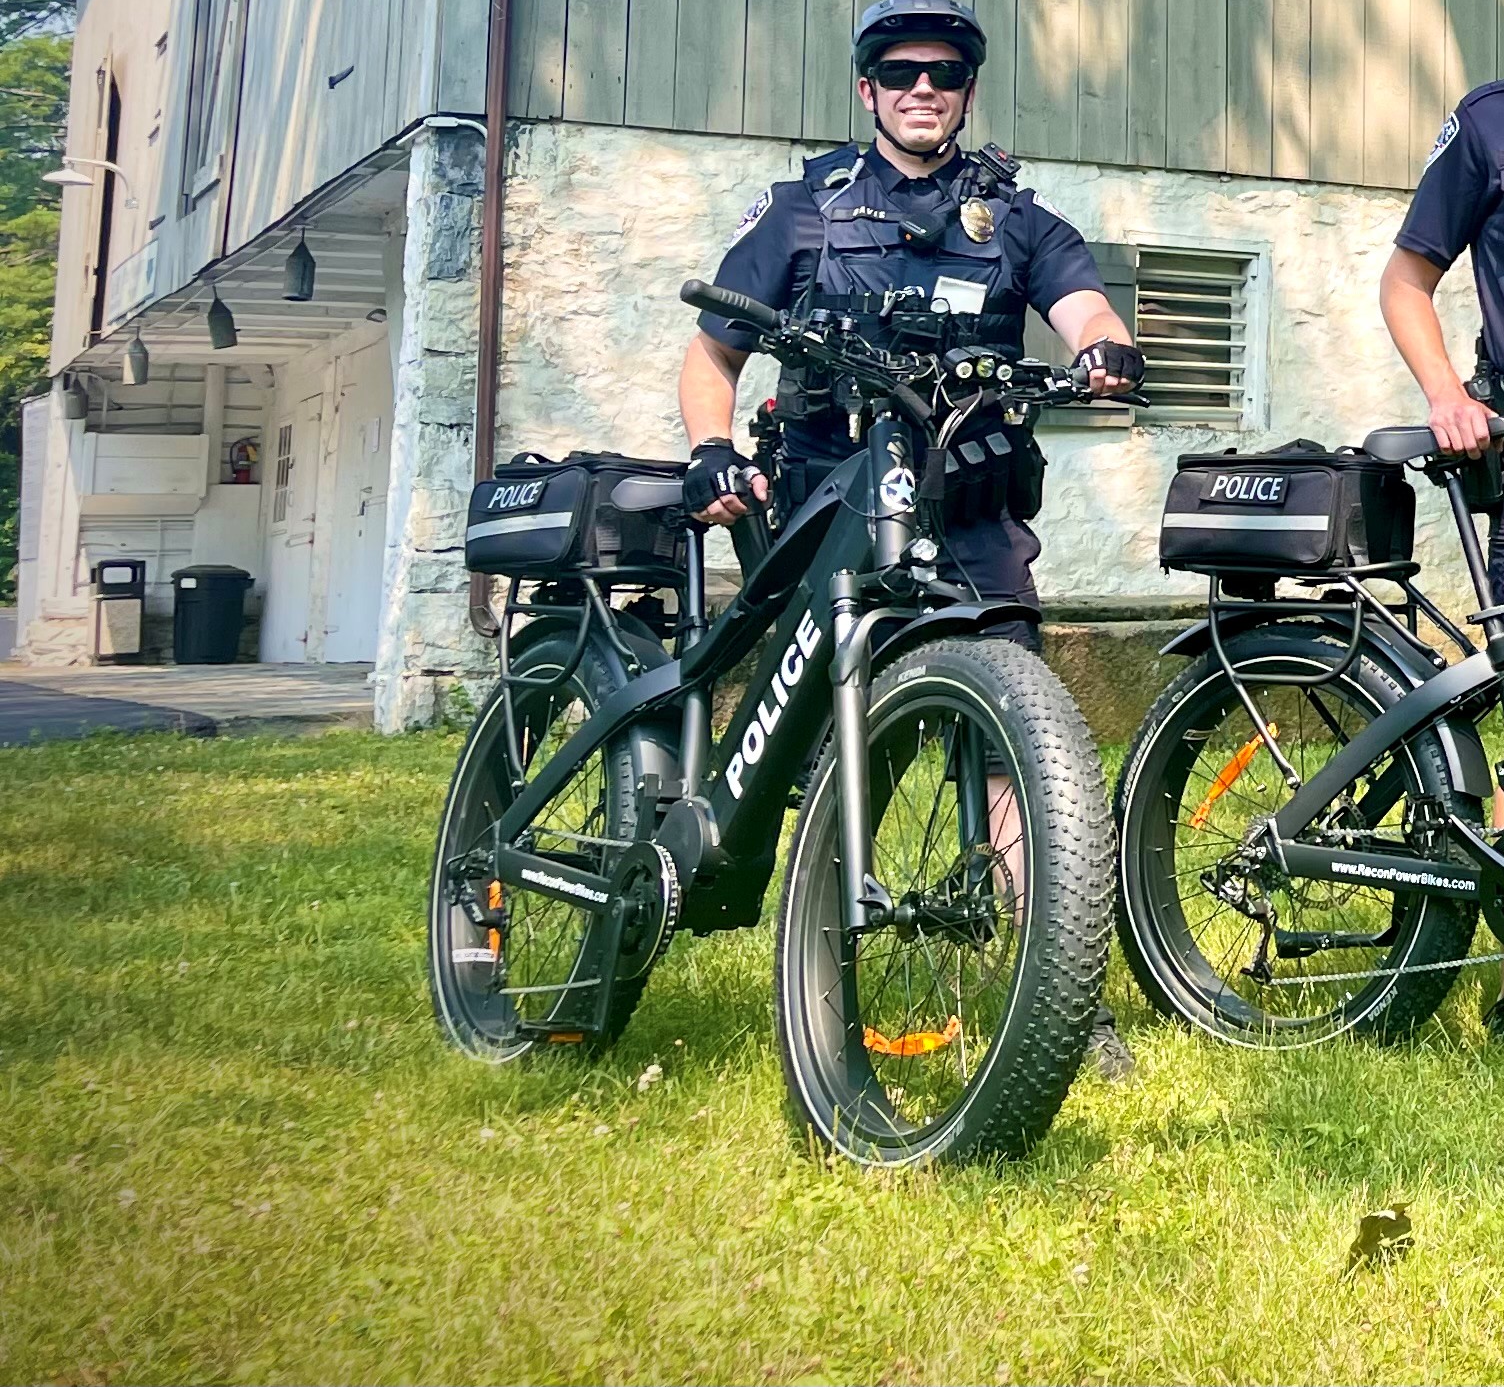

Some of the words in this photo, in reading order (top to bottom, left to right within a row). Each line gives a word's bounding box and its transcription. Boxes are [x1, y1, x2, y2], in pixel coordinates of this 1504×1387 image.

[486, 480, 543, 509] POLICE
[1209, 475, 1284, 501] POLICE
[725, 608, 822, 800] POLICE
[1331, 861, 1476, 891] www.ReconPowerBikes.com
[1367, 985, 1399, 1022] KENDA
